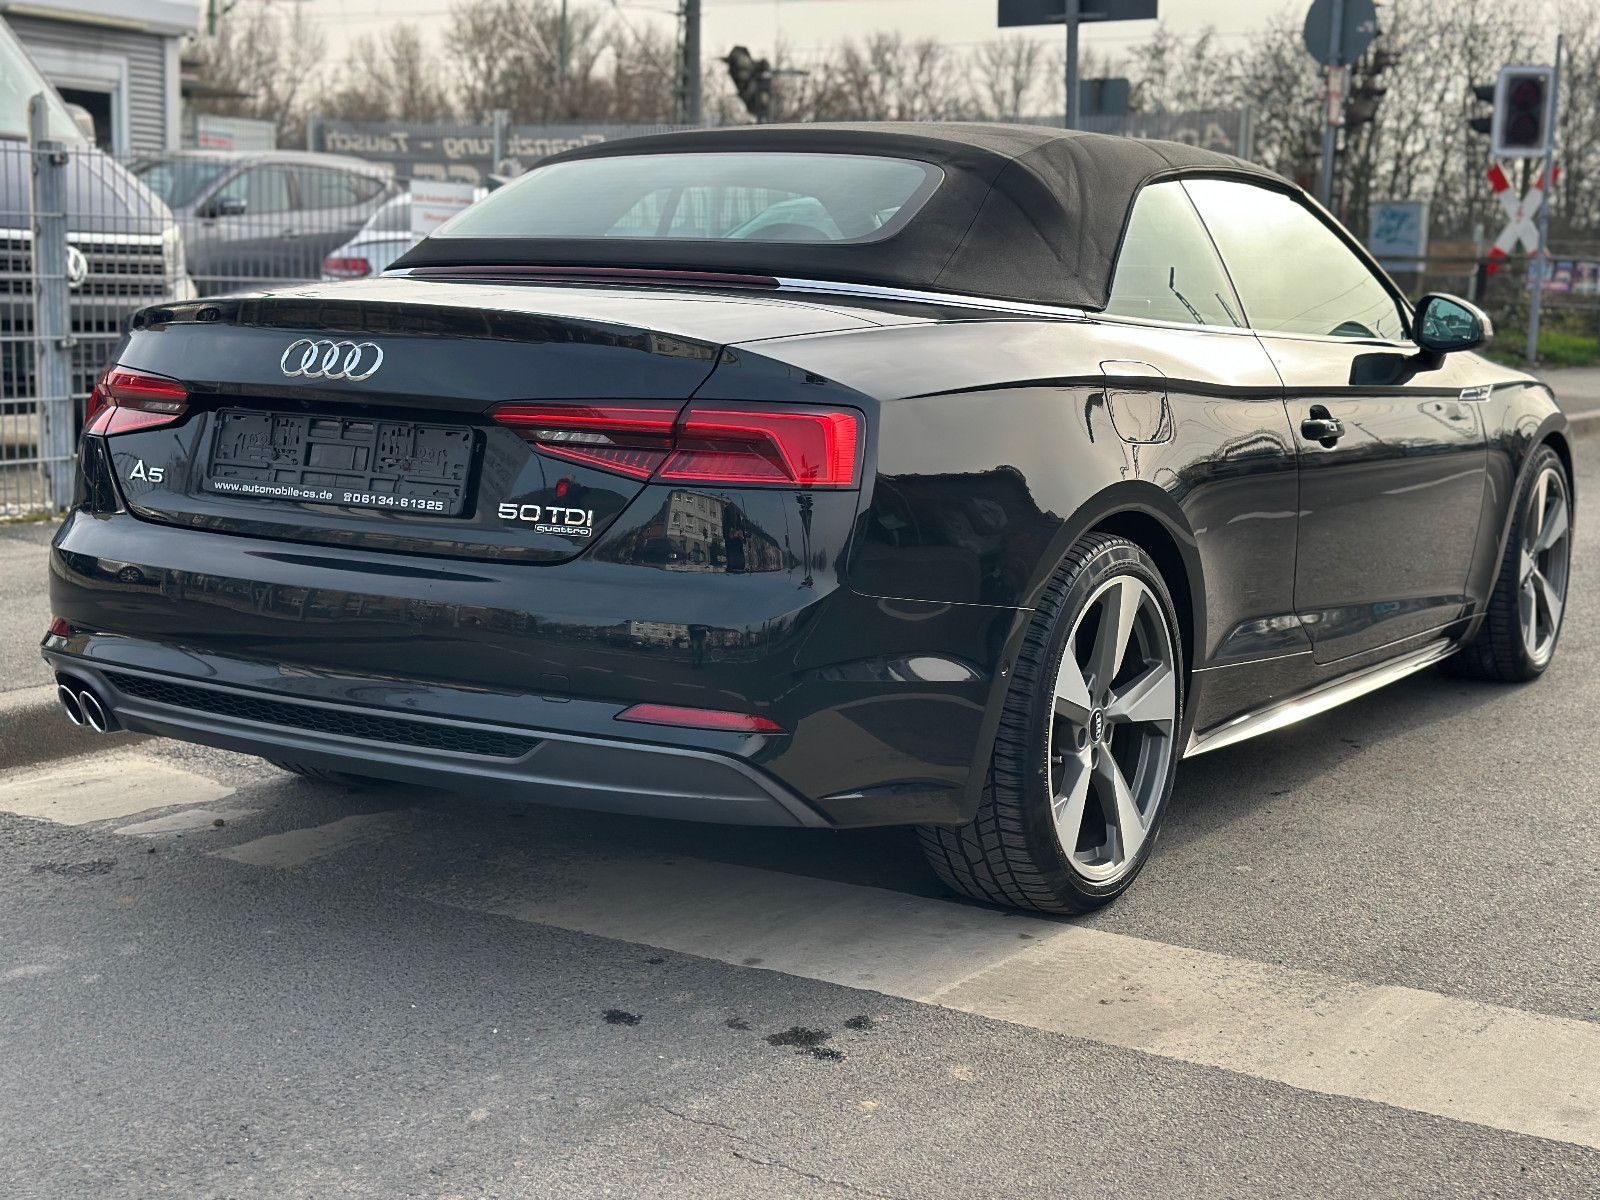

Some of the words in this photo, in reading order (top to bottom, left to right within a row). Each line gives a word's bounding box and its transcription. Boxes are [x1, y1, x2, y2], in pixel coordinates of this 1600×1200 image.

[129, 459, 165, 483] A5
[214, 481, 333, 500] www.automobile-cs.de
[498, 502, 541, 522] 50
[545, 506, 593, 527] TDI
[536, 525, 590, 536] quattro
